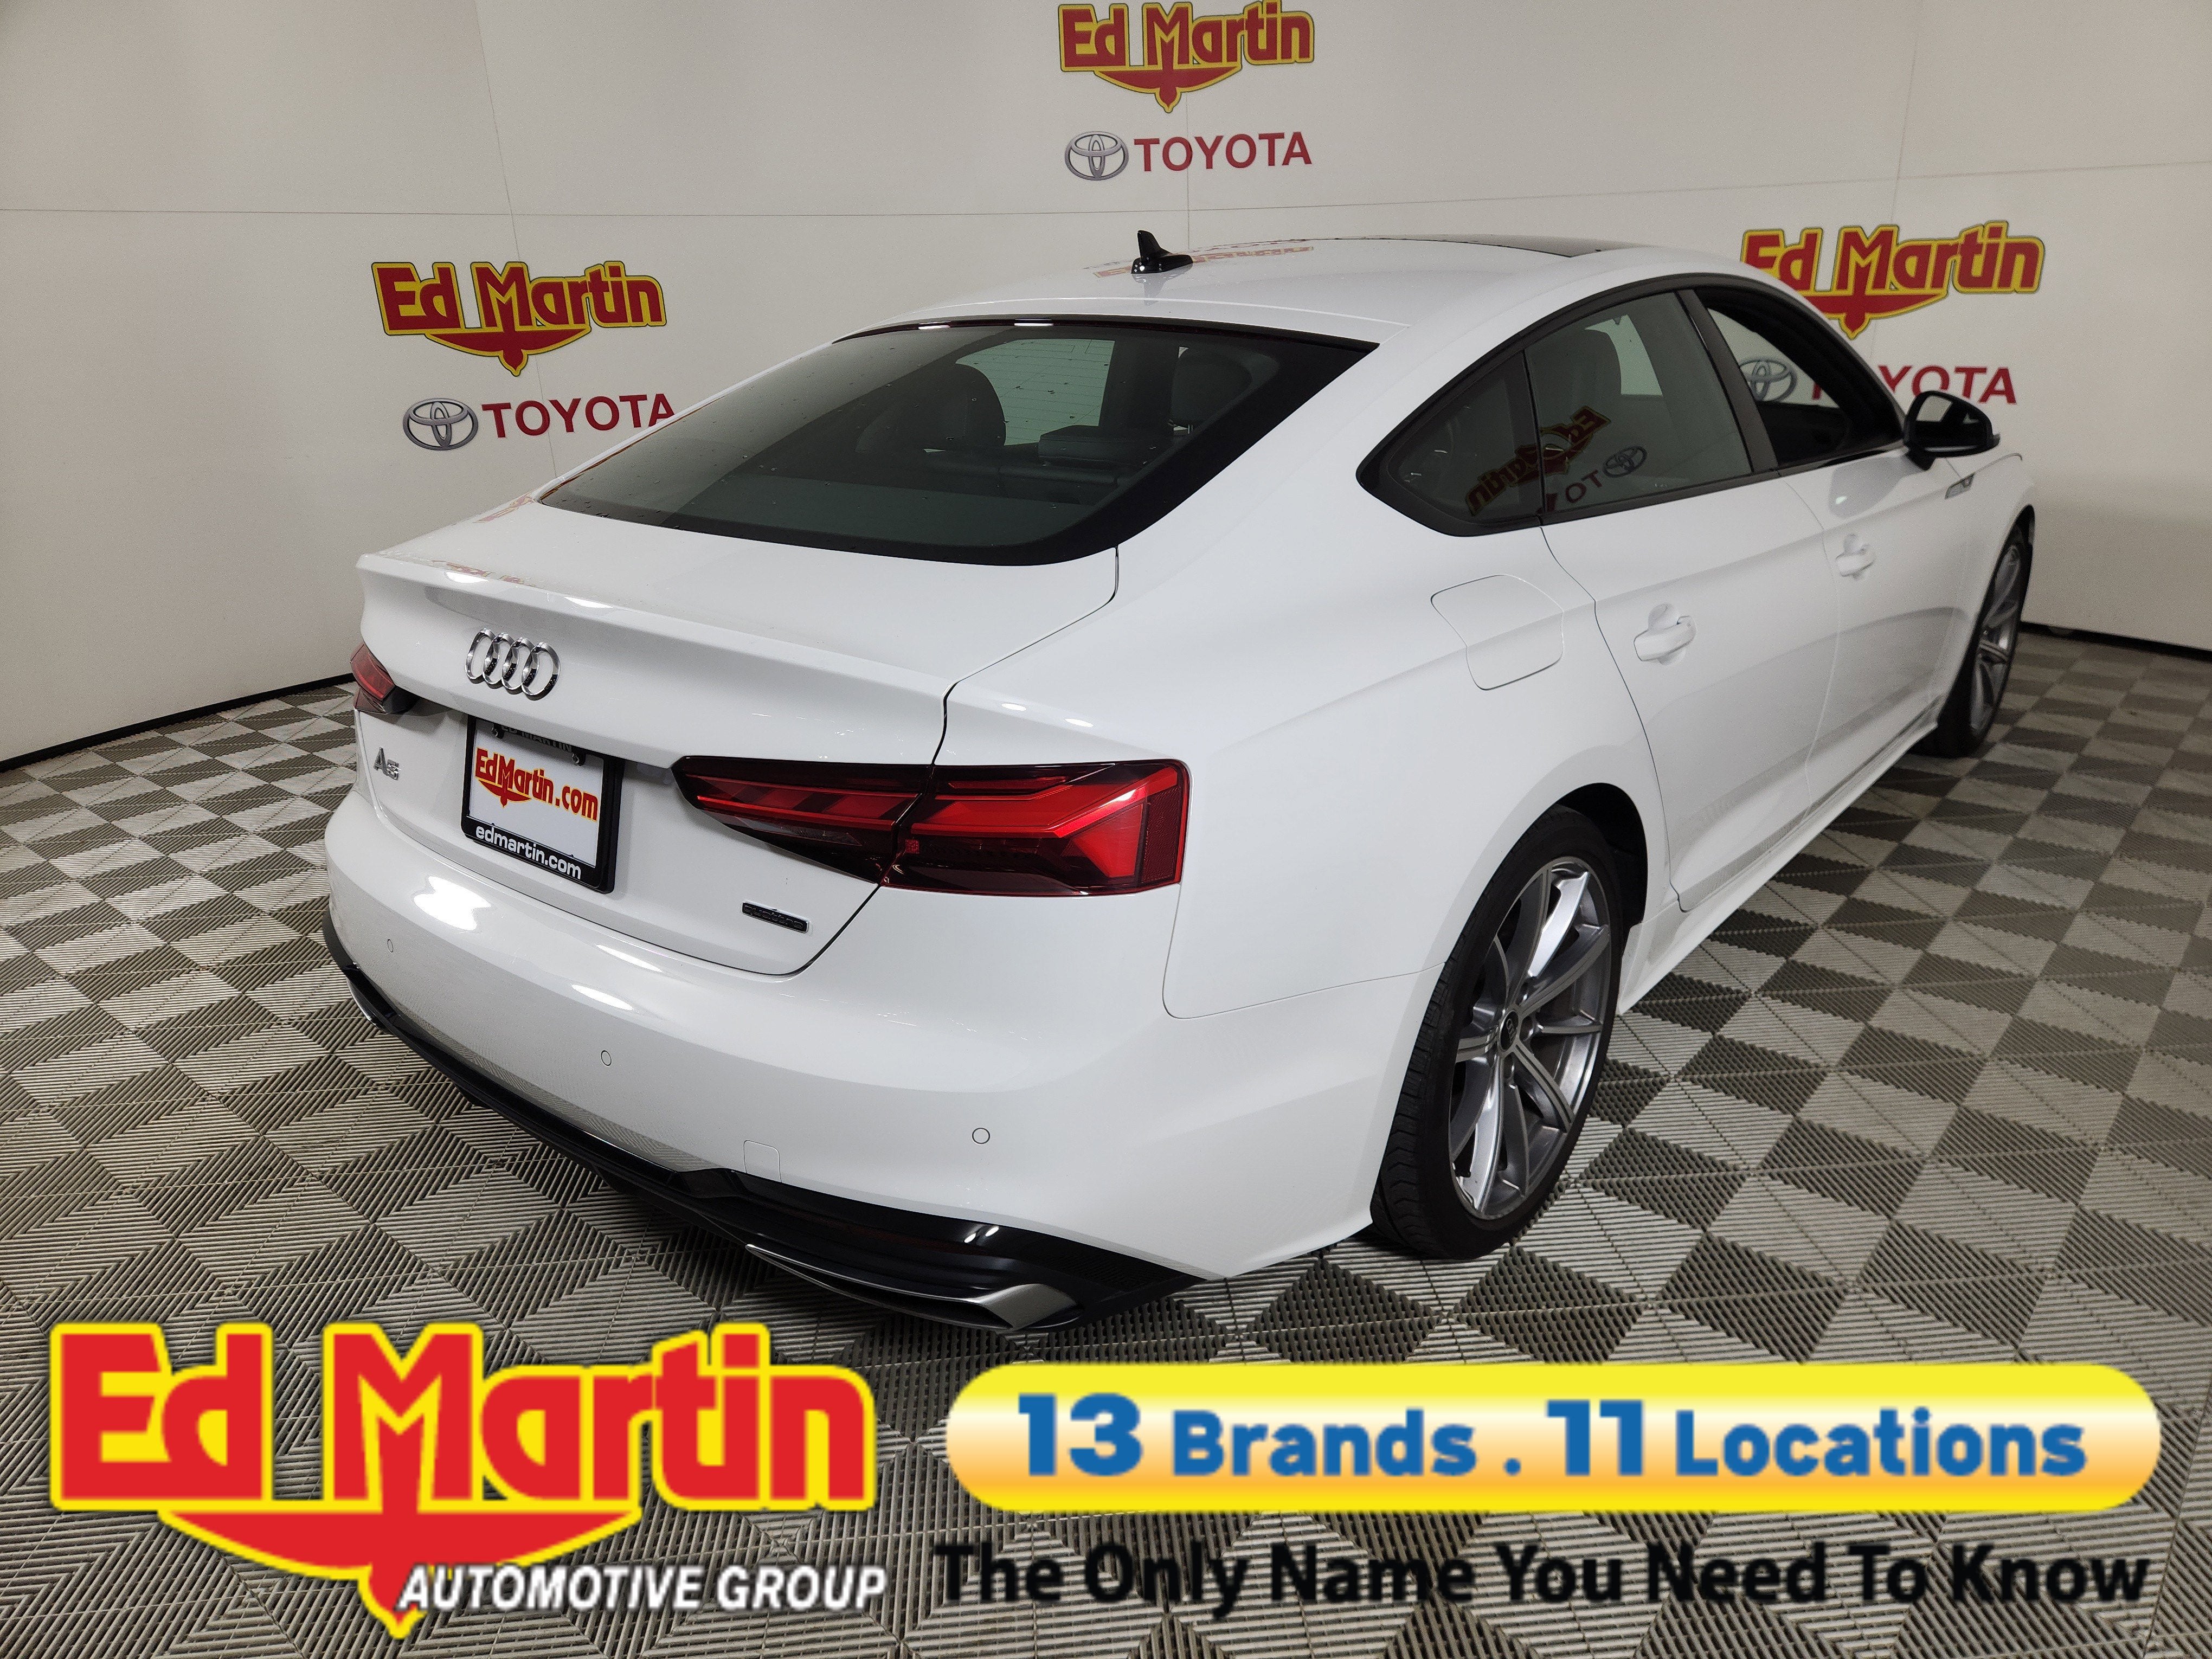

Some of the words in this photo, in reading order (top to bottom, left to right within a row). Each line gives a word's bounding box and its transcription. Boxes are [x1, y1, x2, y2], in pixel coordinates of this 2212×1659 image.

[1058, 3, 1129, 72] Ed
[1142, 0, 1314, 68] Martin
[1134, 132, 1312, 171] TOYOTA
[1832, 220, 2045, 293] Martin
[371, 262, 465, 335] Ed
[471, 260, 666, 330] Martin
[1813, 365, 2017, 405] YOTA
[482, 394, 675, 438] TOYOTA
[374, 747, 400, 780] A5
[475, 826, 581, 879] edmartin.com
